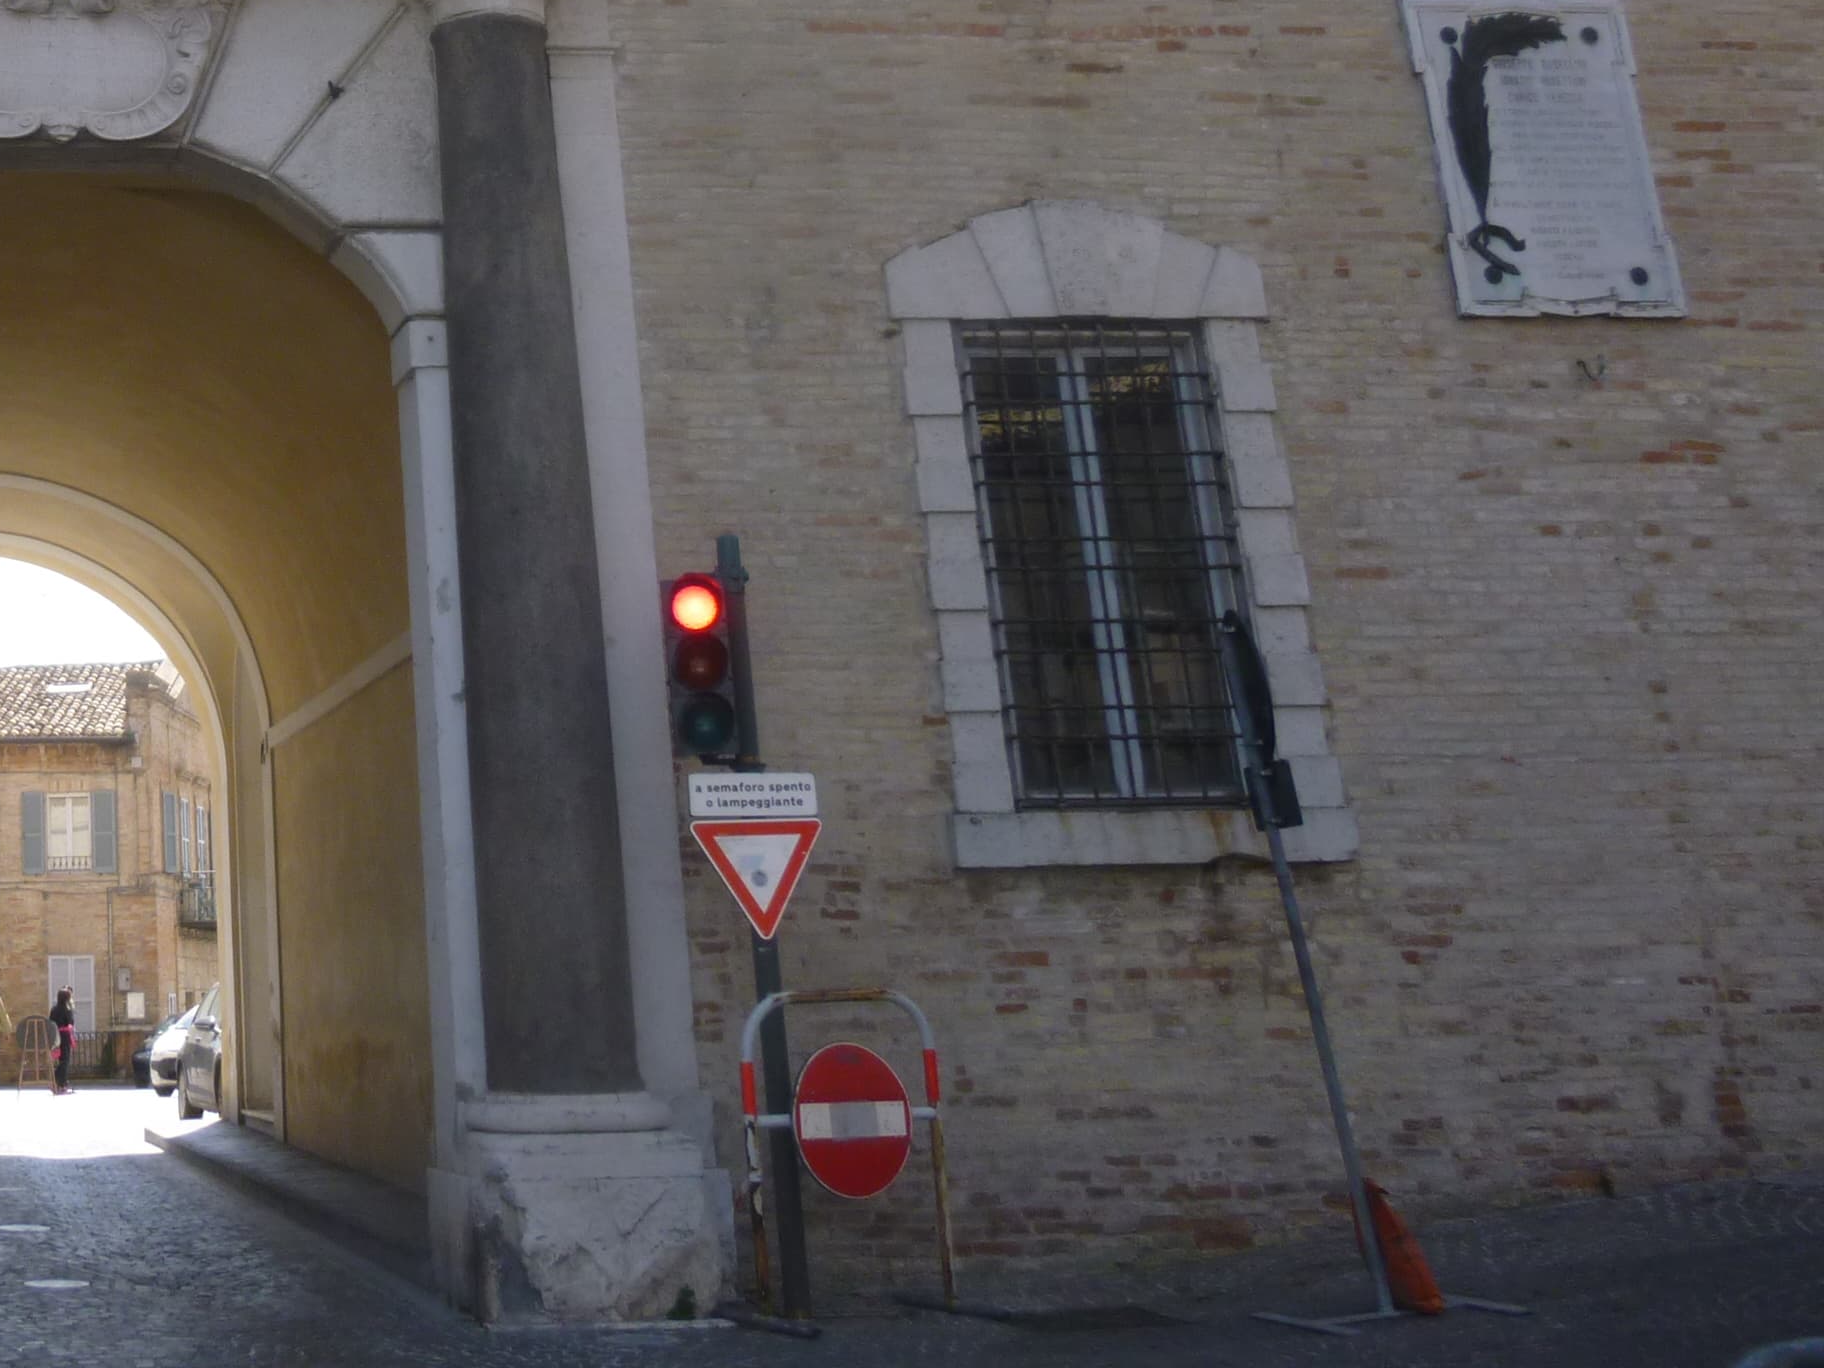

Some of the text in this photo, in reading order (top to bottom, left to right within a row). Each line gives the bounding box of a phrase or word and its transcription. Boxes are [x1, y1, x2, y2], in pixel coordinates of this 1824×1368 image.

[695, 782, 811, 793] a semaforo spento
[706, 797, 804, 809] o lampeggiante
